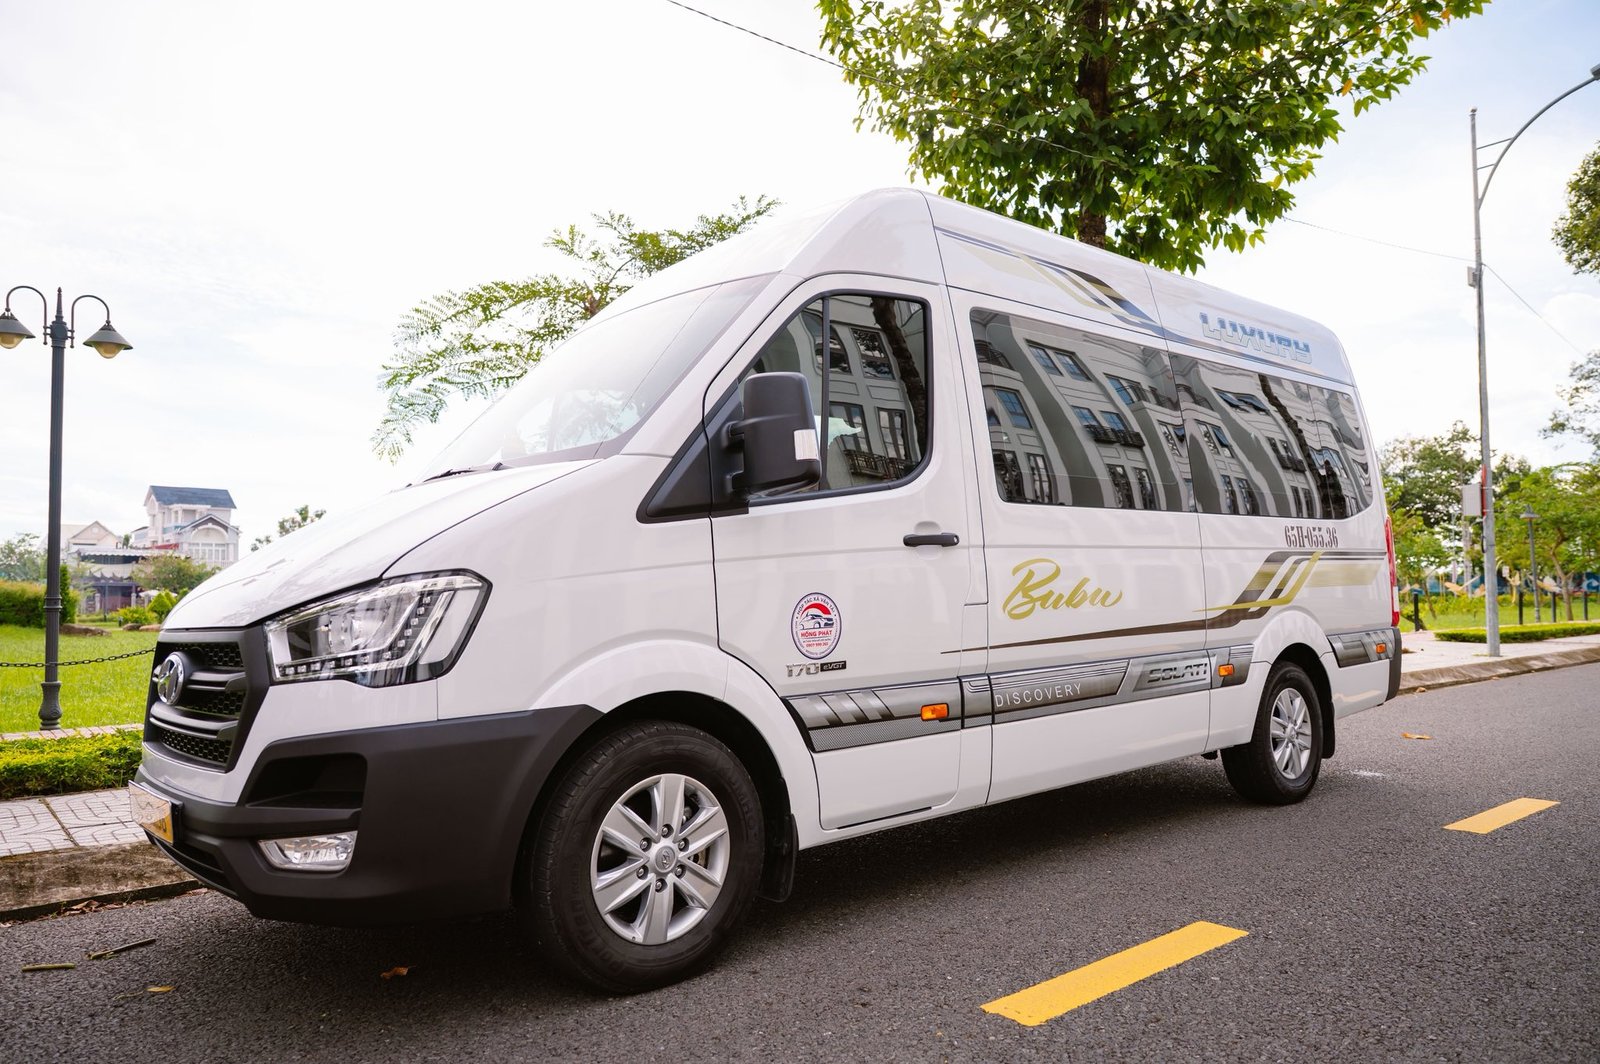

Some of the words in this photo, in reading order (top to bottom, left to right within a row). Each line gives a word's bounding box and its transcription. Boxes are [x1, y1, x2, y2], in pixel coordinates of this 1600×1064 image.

[1199, 311, 1312, 364] LUXURY
[1284, 525, 1339, 549] 65H-055.36
[1002, 557, 1123, 620] Bubu
[786, 662, 820, 678] 170
[1147, 662, 1208, 684] SOLATI
[994, 682, 1082, 708] DISCOVERY
